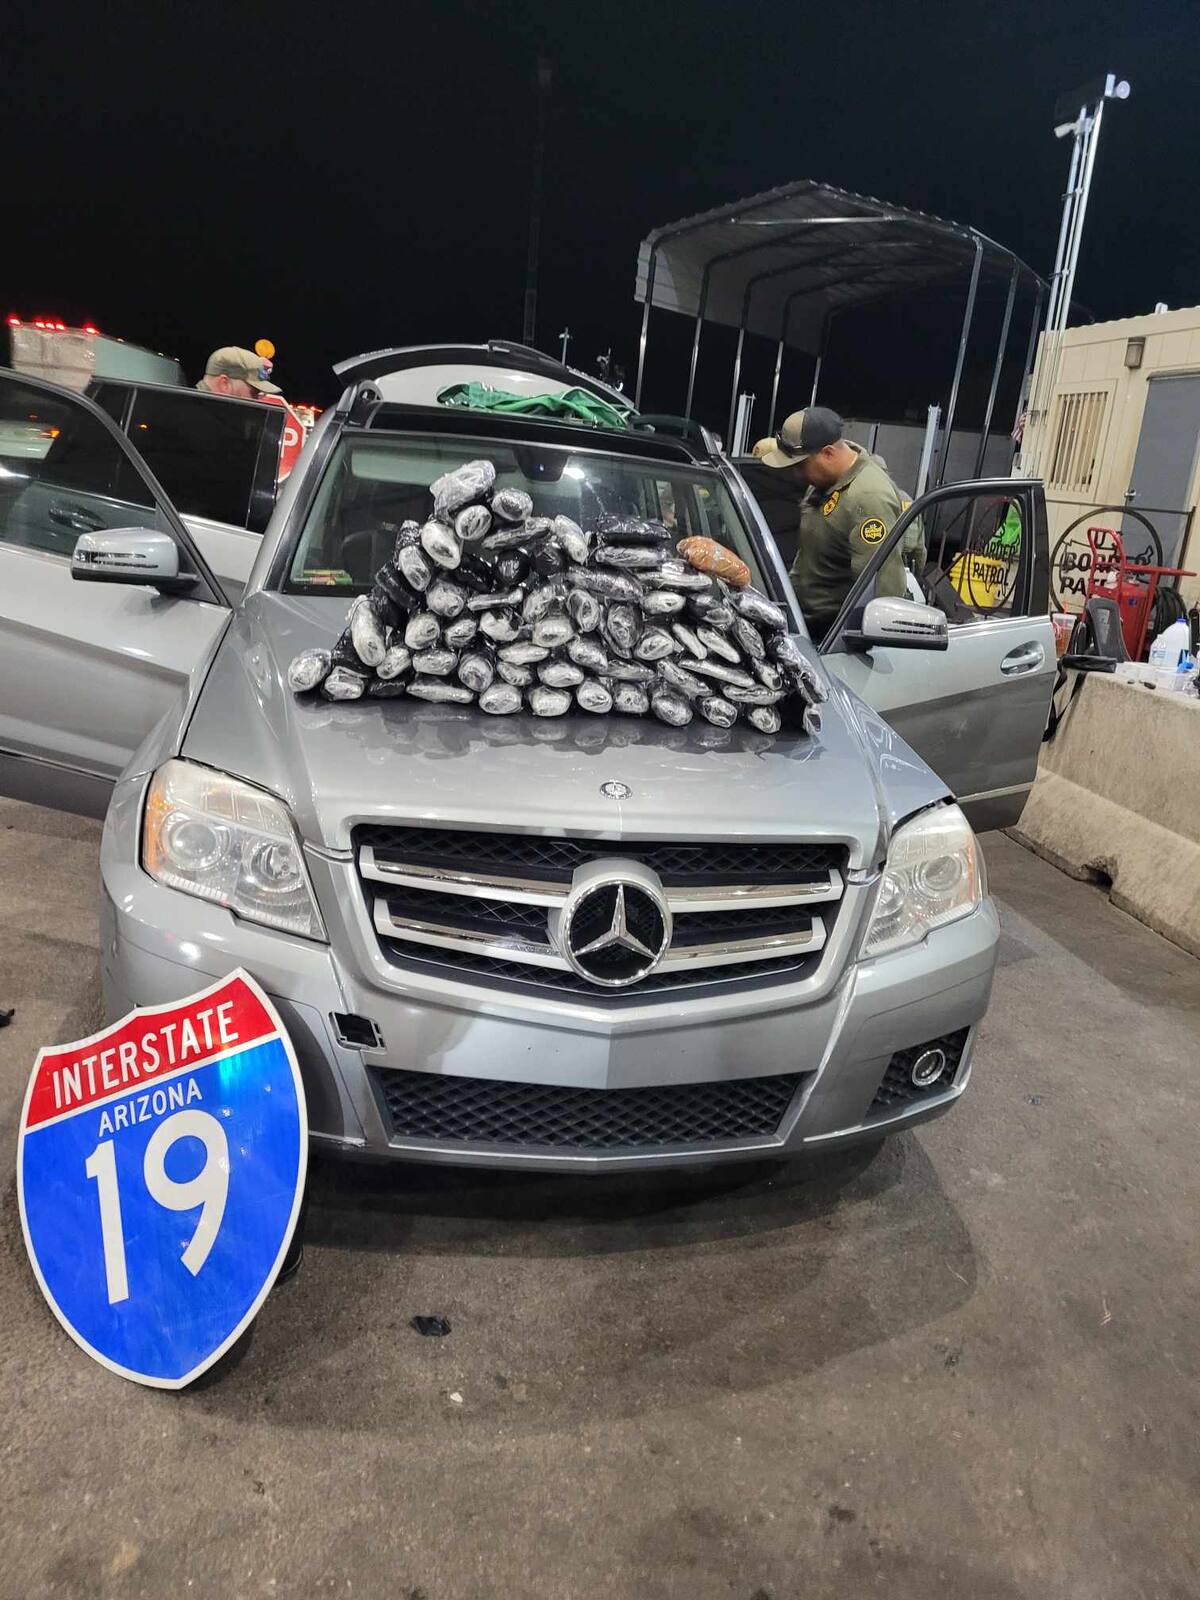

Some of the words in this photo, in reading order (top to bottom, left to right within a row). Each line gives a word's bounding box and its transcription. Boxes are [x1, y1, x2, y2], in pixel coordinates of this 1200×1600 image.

[972, 562, 1009, 587] PATROL
[975, 538, 1017, 563] ORDER
[53, 1000, 239, 1109] INTERSTATE
[98, 1077, 203, 1137] ARIZONA
[85, 1109, 230, 1305] 19
